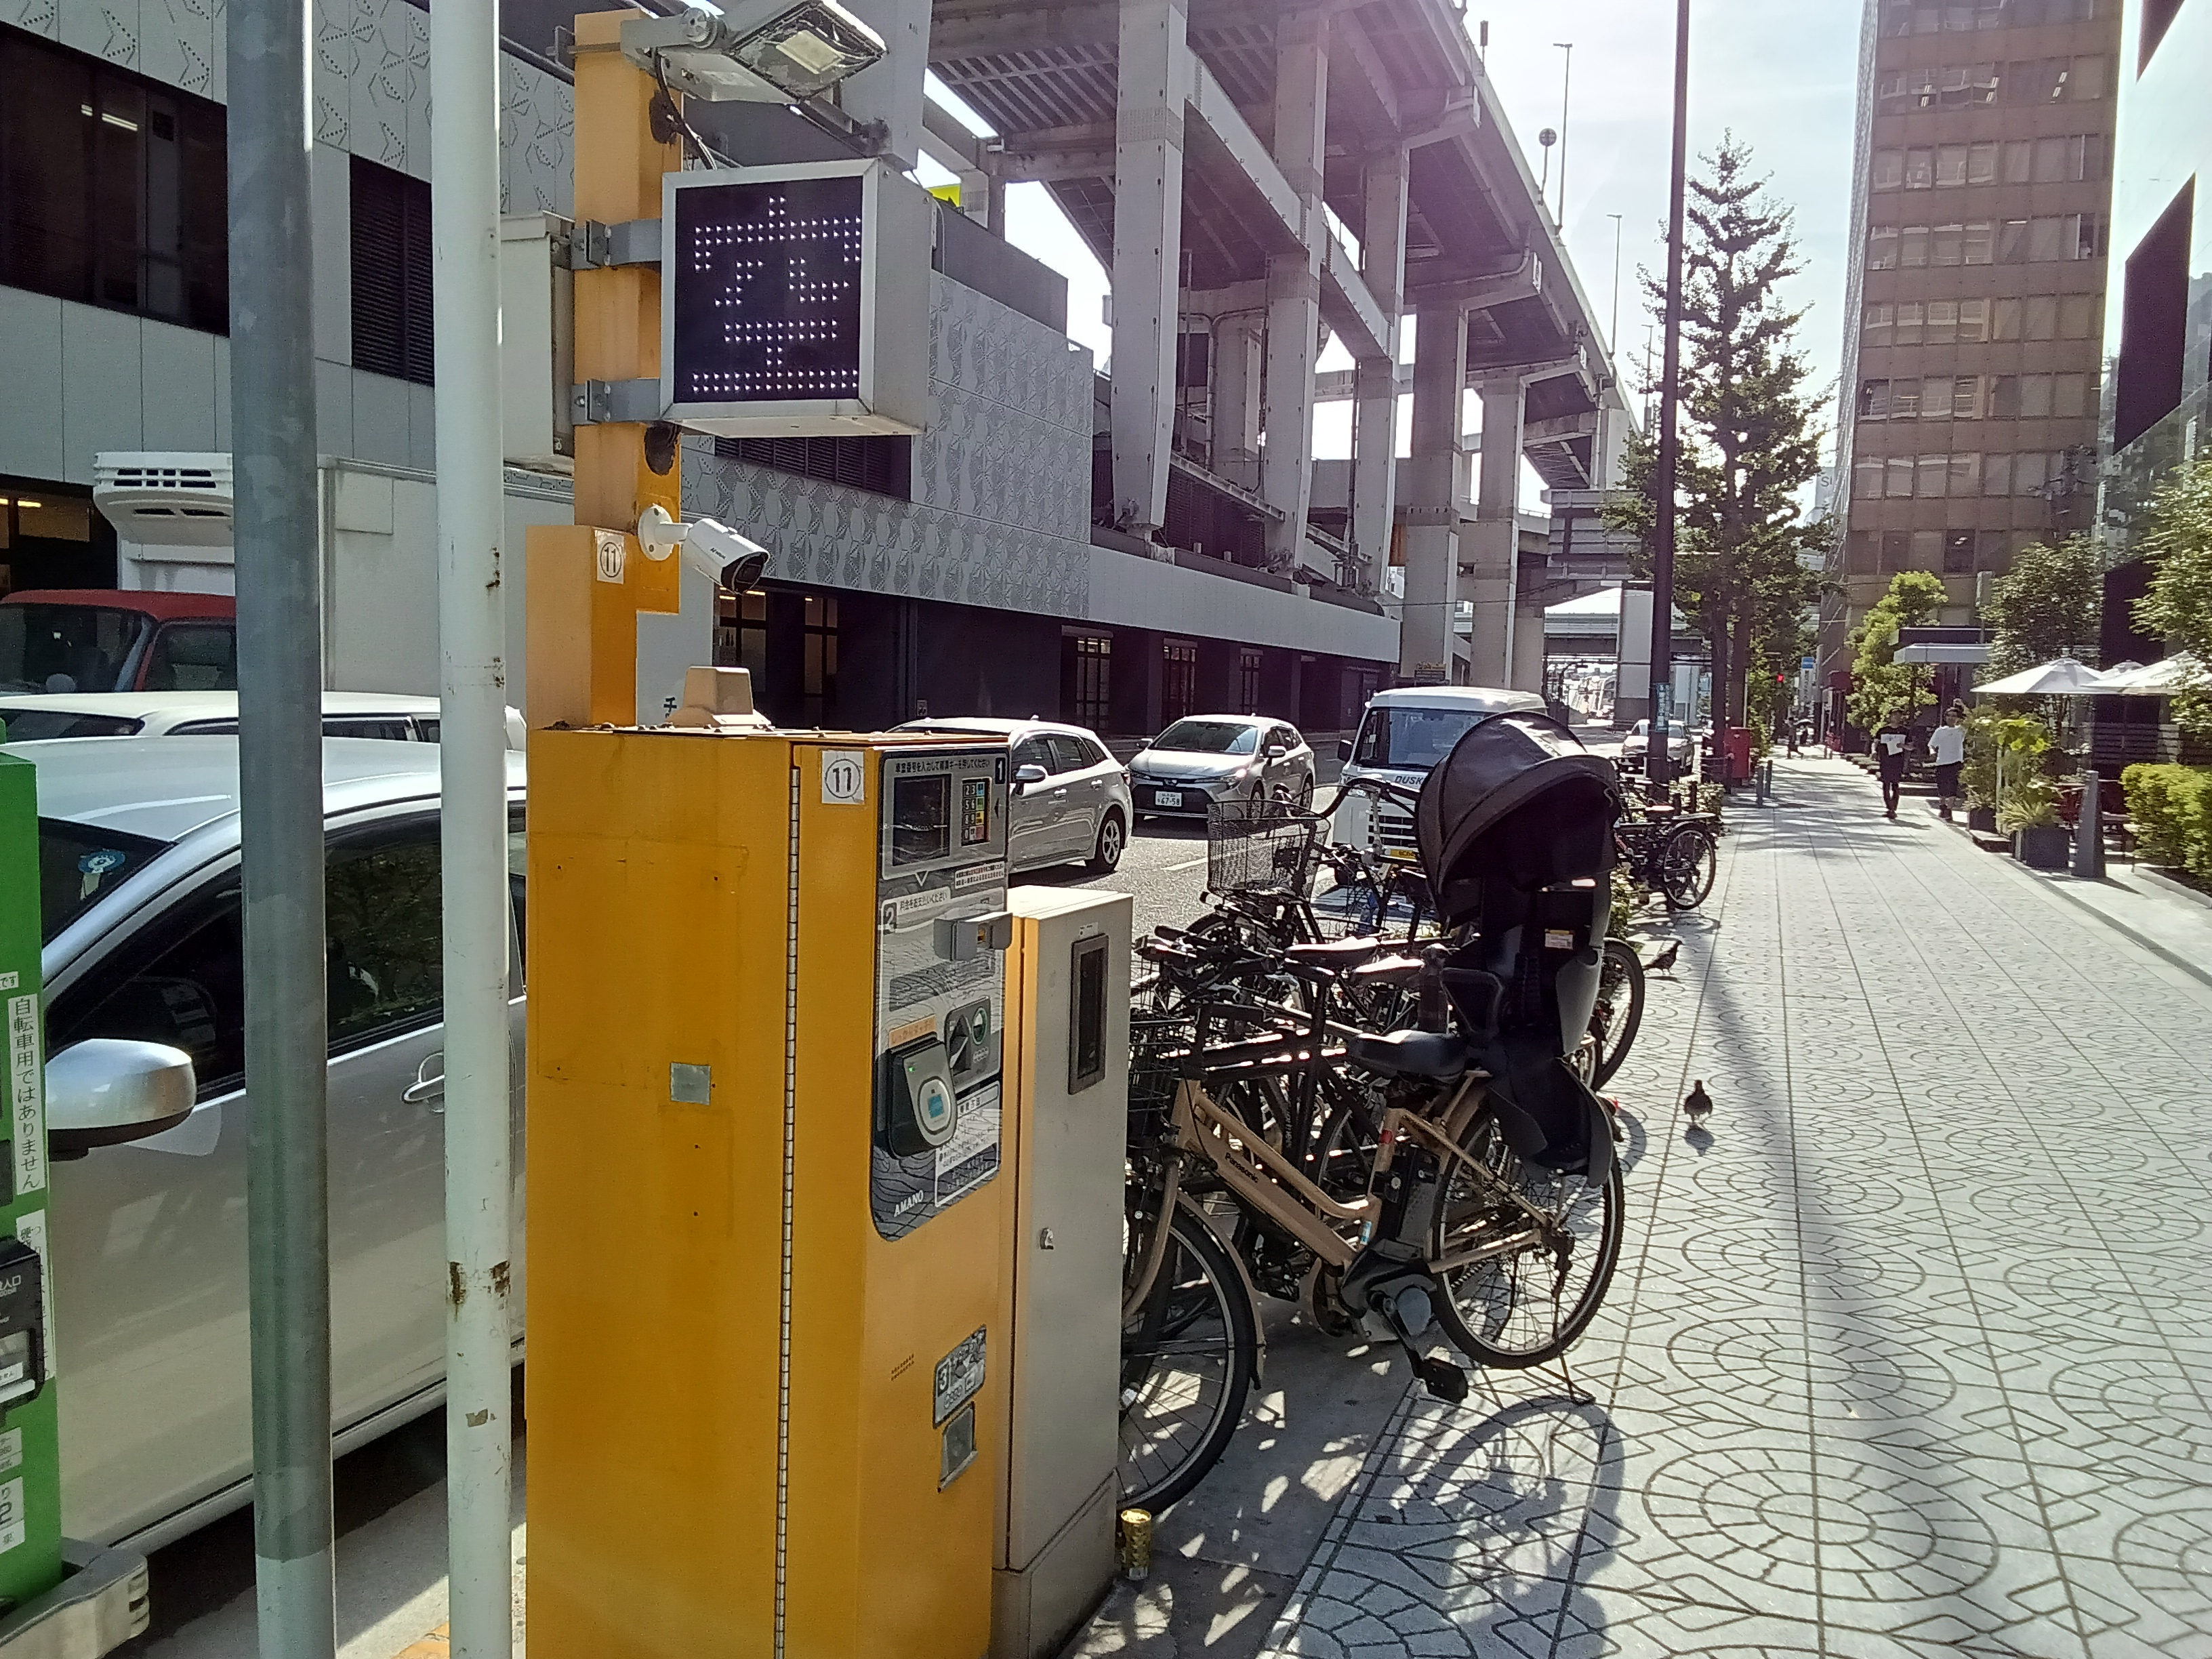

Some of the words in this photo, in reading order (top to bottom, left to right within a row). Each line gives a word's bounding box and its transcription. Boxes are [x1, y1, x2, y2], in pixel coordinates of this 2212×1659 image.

[694, 196, 861, 393] 空
[604, 547, 616, 573] 11
[832, 766, 852, 793] 11
[14, 998, 40, 1191] 自転車用ではありません
[1225, 1152, 1258, 1183] Panasonic
[894, 1189, 924, 1217] AMANO
